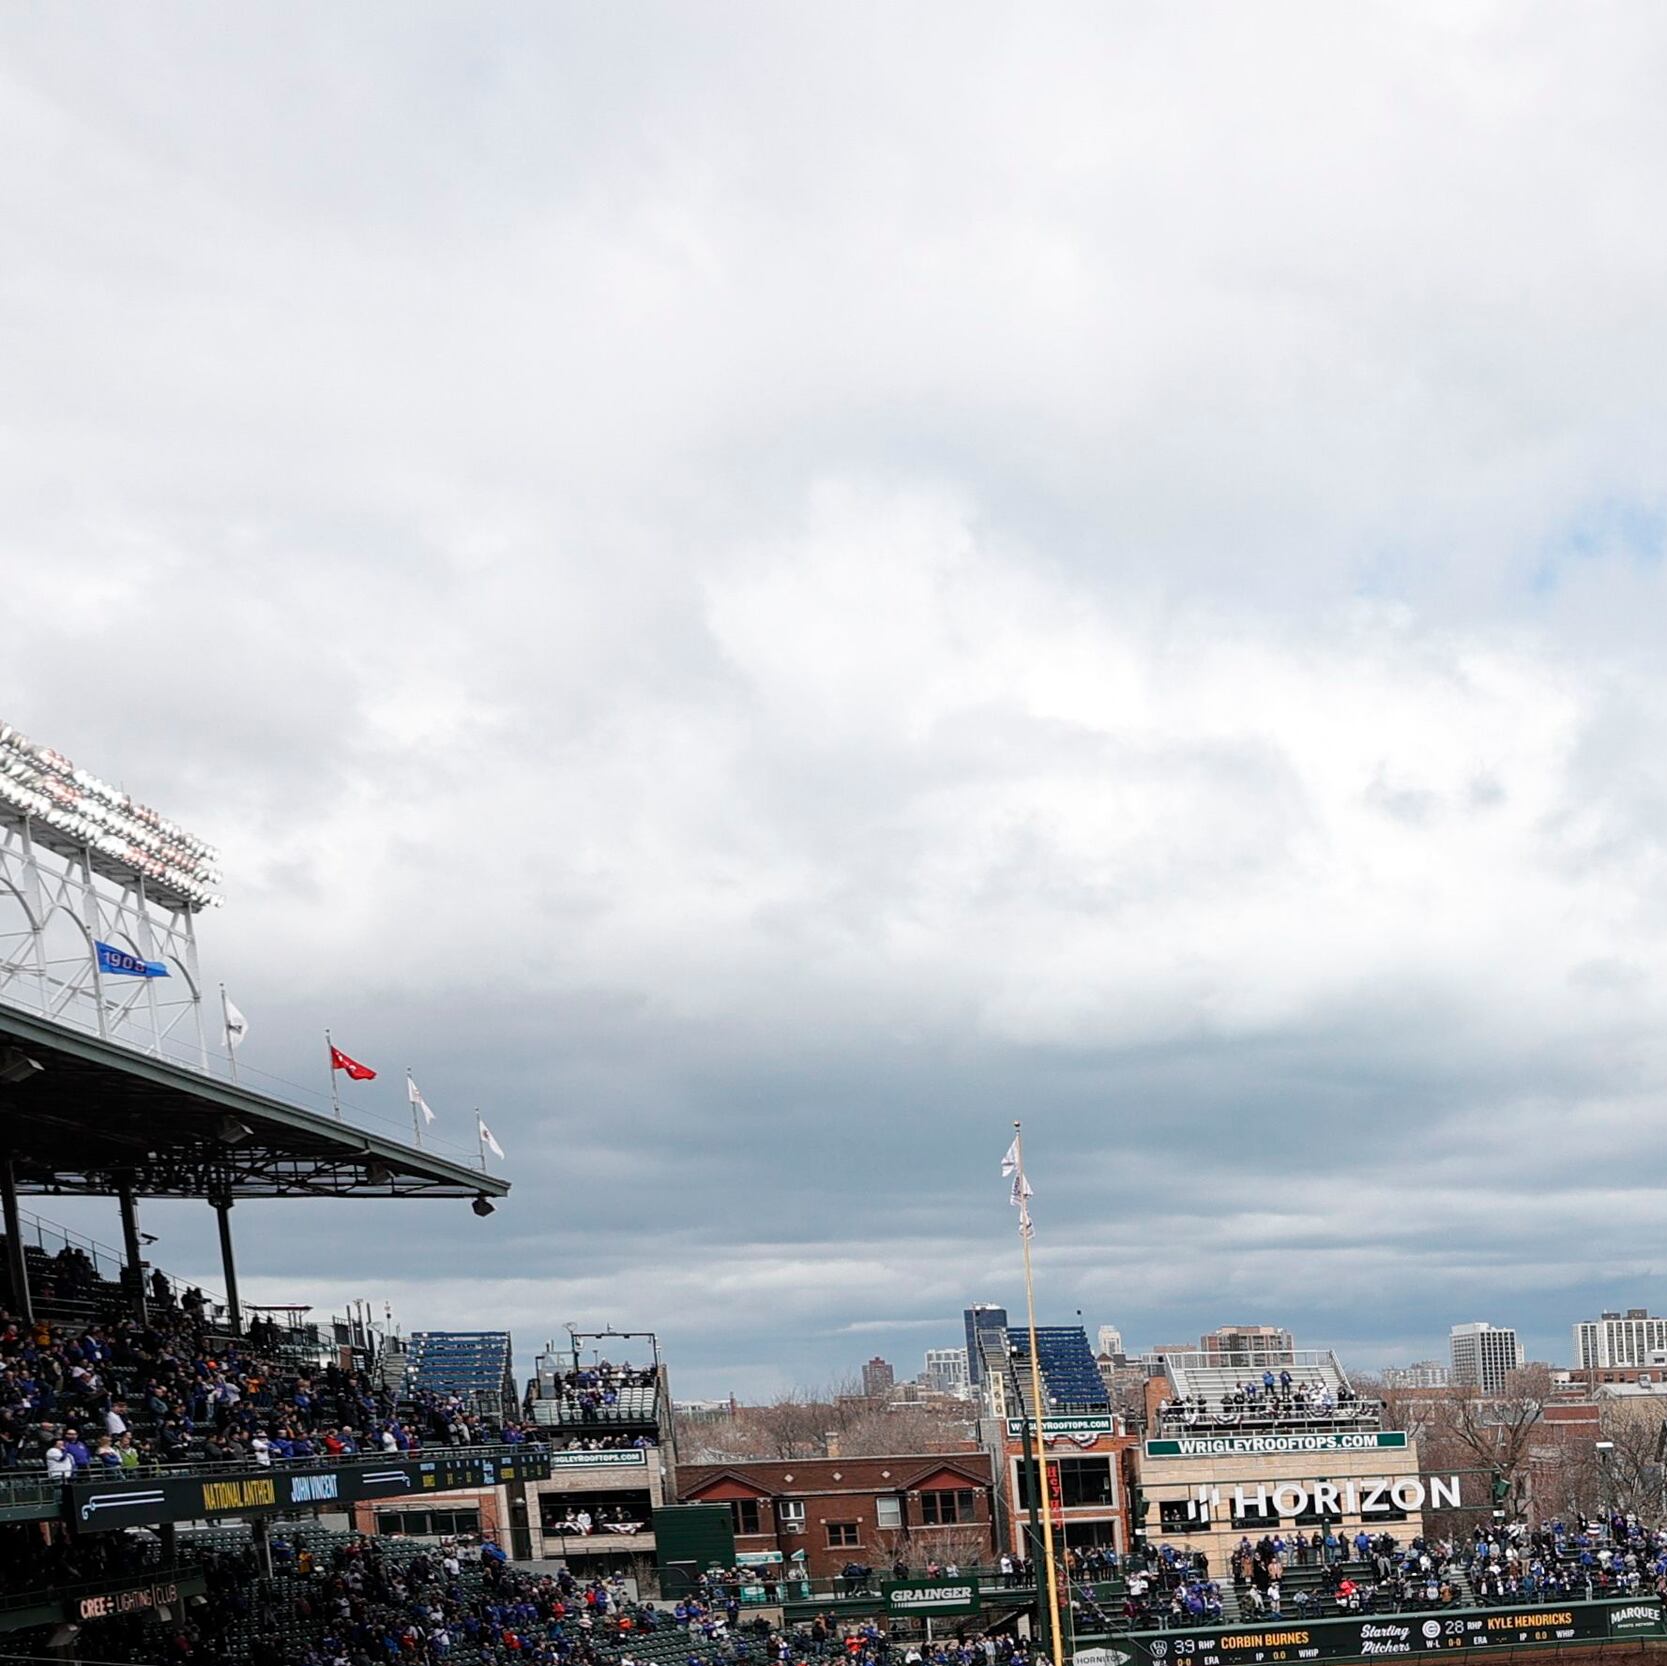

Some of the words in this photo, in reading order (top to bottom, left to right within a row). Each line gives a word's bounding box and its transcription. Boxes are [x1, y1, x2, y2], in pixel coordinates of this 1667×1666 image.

[1011, 1420, 1109, 1432] WGLYROOFTOPS.COM
[1178, 1435, 1378, 1454] WRIGLEYROOFTOPS.COM
[203, 1481, 243, 1511] NATIONAL
[243, 1479, 275, 1507] ANTHEM
[291, 1476, 310, 1502] JOHN
[310, 1474, 338, 1499] VINCENT
[1235, 1476, 1461, 1518] HORIZON
[80, 1597, 106, 1619] CREE
[116, 1589, 152, 1613] LIGHTING
[156, 1584, 177, 1605] CLUB
[890, 1586, 972, 1602] GRAINGER
[1445, 1620, 1464, 1634] 28
[1467, 1621, 1483, 1631] RHP
[1488, 1615, 1513, 1630] KYLE
[1515, 1612, 1572, 1627] HENDRICKS
[1611, 1606, 1661, 1622] MARQUEE
[1361, 1624, 1410, 1640] Starting
[1426, 1639, 1440, 1648] W-L
[1448, 1637, 1461, 1646] 0-0
[1474, 1636, 1487, 1645] ERA
[1520, 1633, 1527, 1641] IP
[1535, 1631, 1547, 1640] 0.0
[1556, 1629, 1575, 1638] WHIP
[1174, 1640, 1195, 1654] 39
[1199, 1640, 1215, 1650] RHP
[1221, 1635, 1262, 1650] CORBIN
[1265, 1631, 1309, 1646] BURNES
[1361, 1639, 1410, 1655] Pitchers
[1076, 1653, 1124, 1665] HORNITOS
[1177, 1657, 1191, 1666] 0-0
[1204, 1656, 1219, 1666] ERA
[1256, 1653, 1264, 1661] IP
[1274, 1651, 1286, 1660] 0.0
[1299, 1648, 1318, 1658] WHIP
